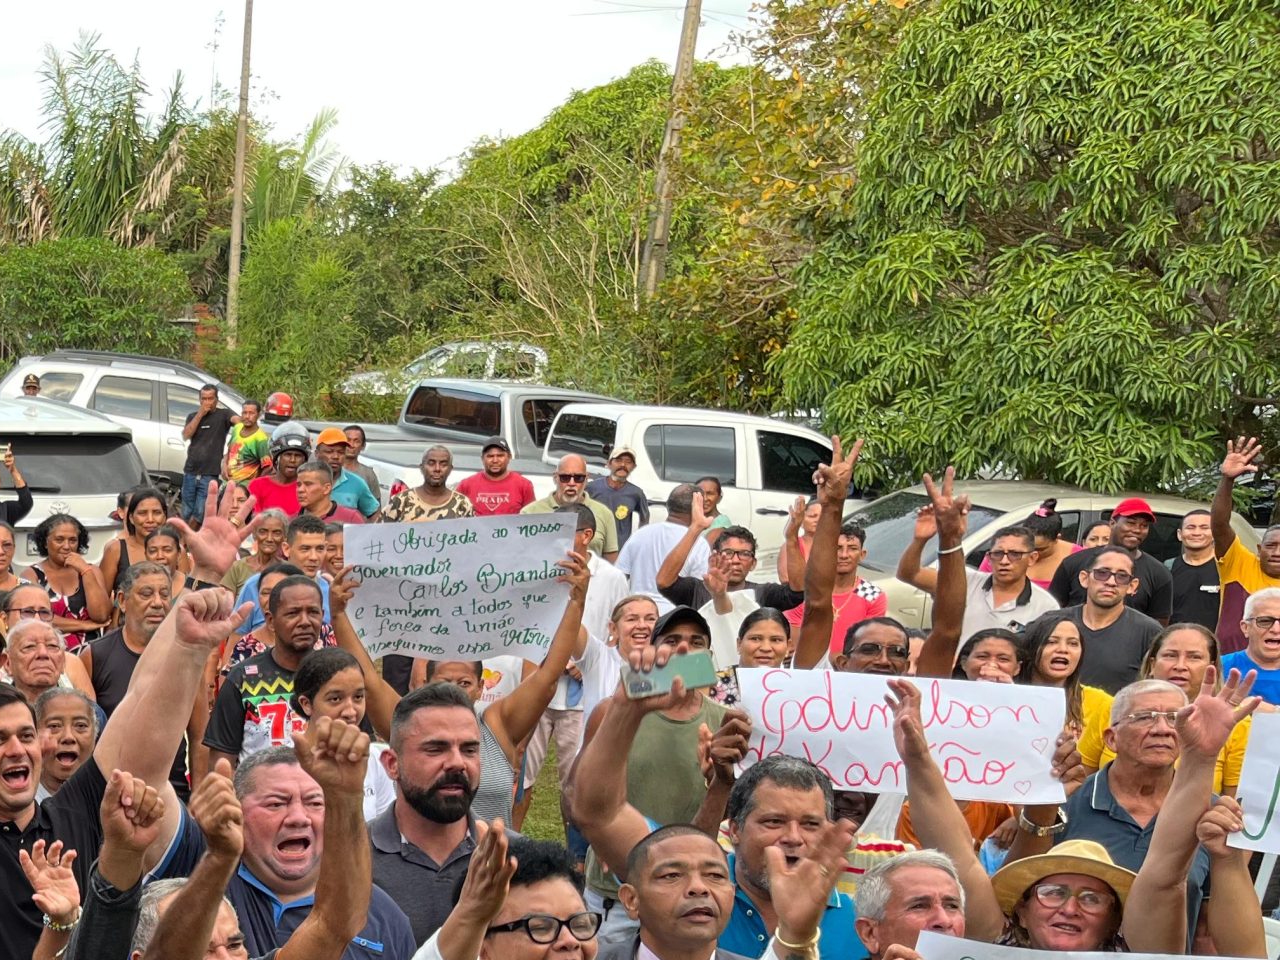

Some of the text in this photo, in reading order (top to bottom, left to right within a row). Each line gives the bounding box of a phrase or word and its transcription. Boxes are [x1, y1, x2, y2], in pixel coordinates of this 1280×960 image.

[393, 528, 477, 554] Obrigada
[492, 527, 508, 539] ao
[517, 523, 563, 538] nosso
[353, 557, 451, 583] governador
[399, 575, 468, 601] Carlos
[355, 606, 364, 619] e
[452, 605, 463, 617] a
[470, 598, 512, 616] todos
[522, 594, 550, 609] que
[430, 623, 450, 636] da
